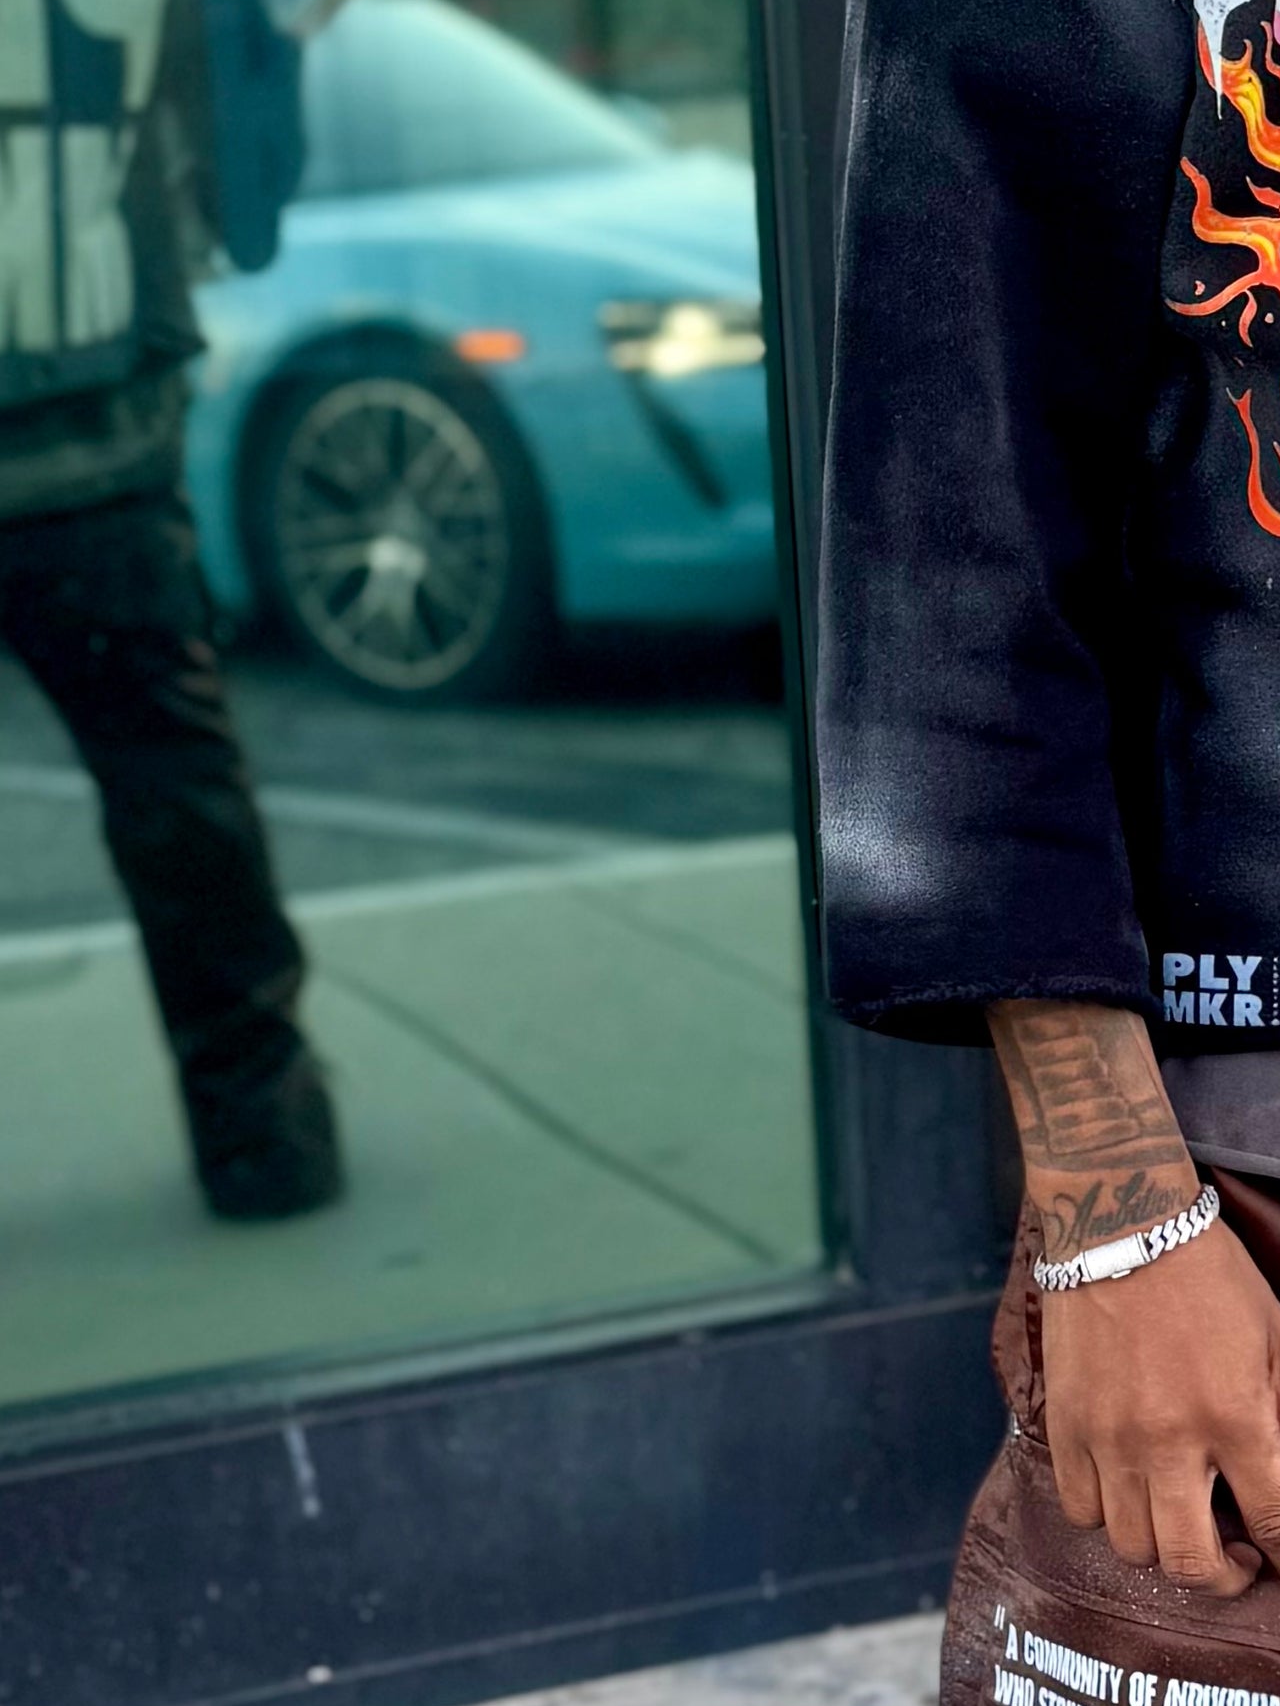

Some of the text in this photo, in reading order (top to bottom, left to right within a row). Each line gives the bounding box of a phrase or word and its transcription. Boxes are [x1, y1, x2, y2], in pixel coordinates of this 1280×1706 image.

[1162, 952, 1263, 992] PLY
[1162, 989, 1266, 1027] MKR
[1024, 1630, 1124, 1705] COMMUNITY
